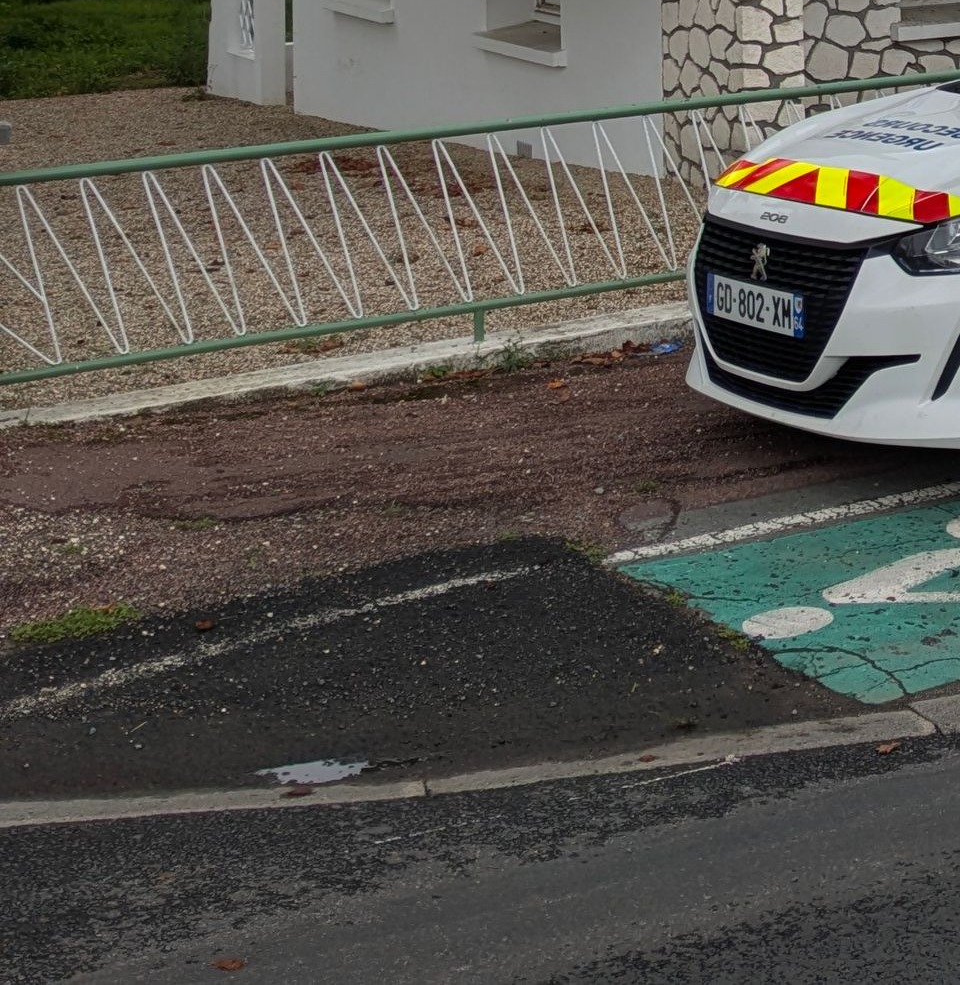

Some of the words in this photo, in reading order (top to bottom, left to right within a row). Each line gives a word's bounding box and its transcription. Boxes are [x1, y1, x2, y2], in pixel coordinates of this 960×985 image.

[760, 211, 789, 224] 208
[716, 282, 792, 329] GD-802-XM
[794, 316, 804, 331] 64
